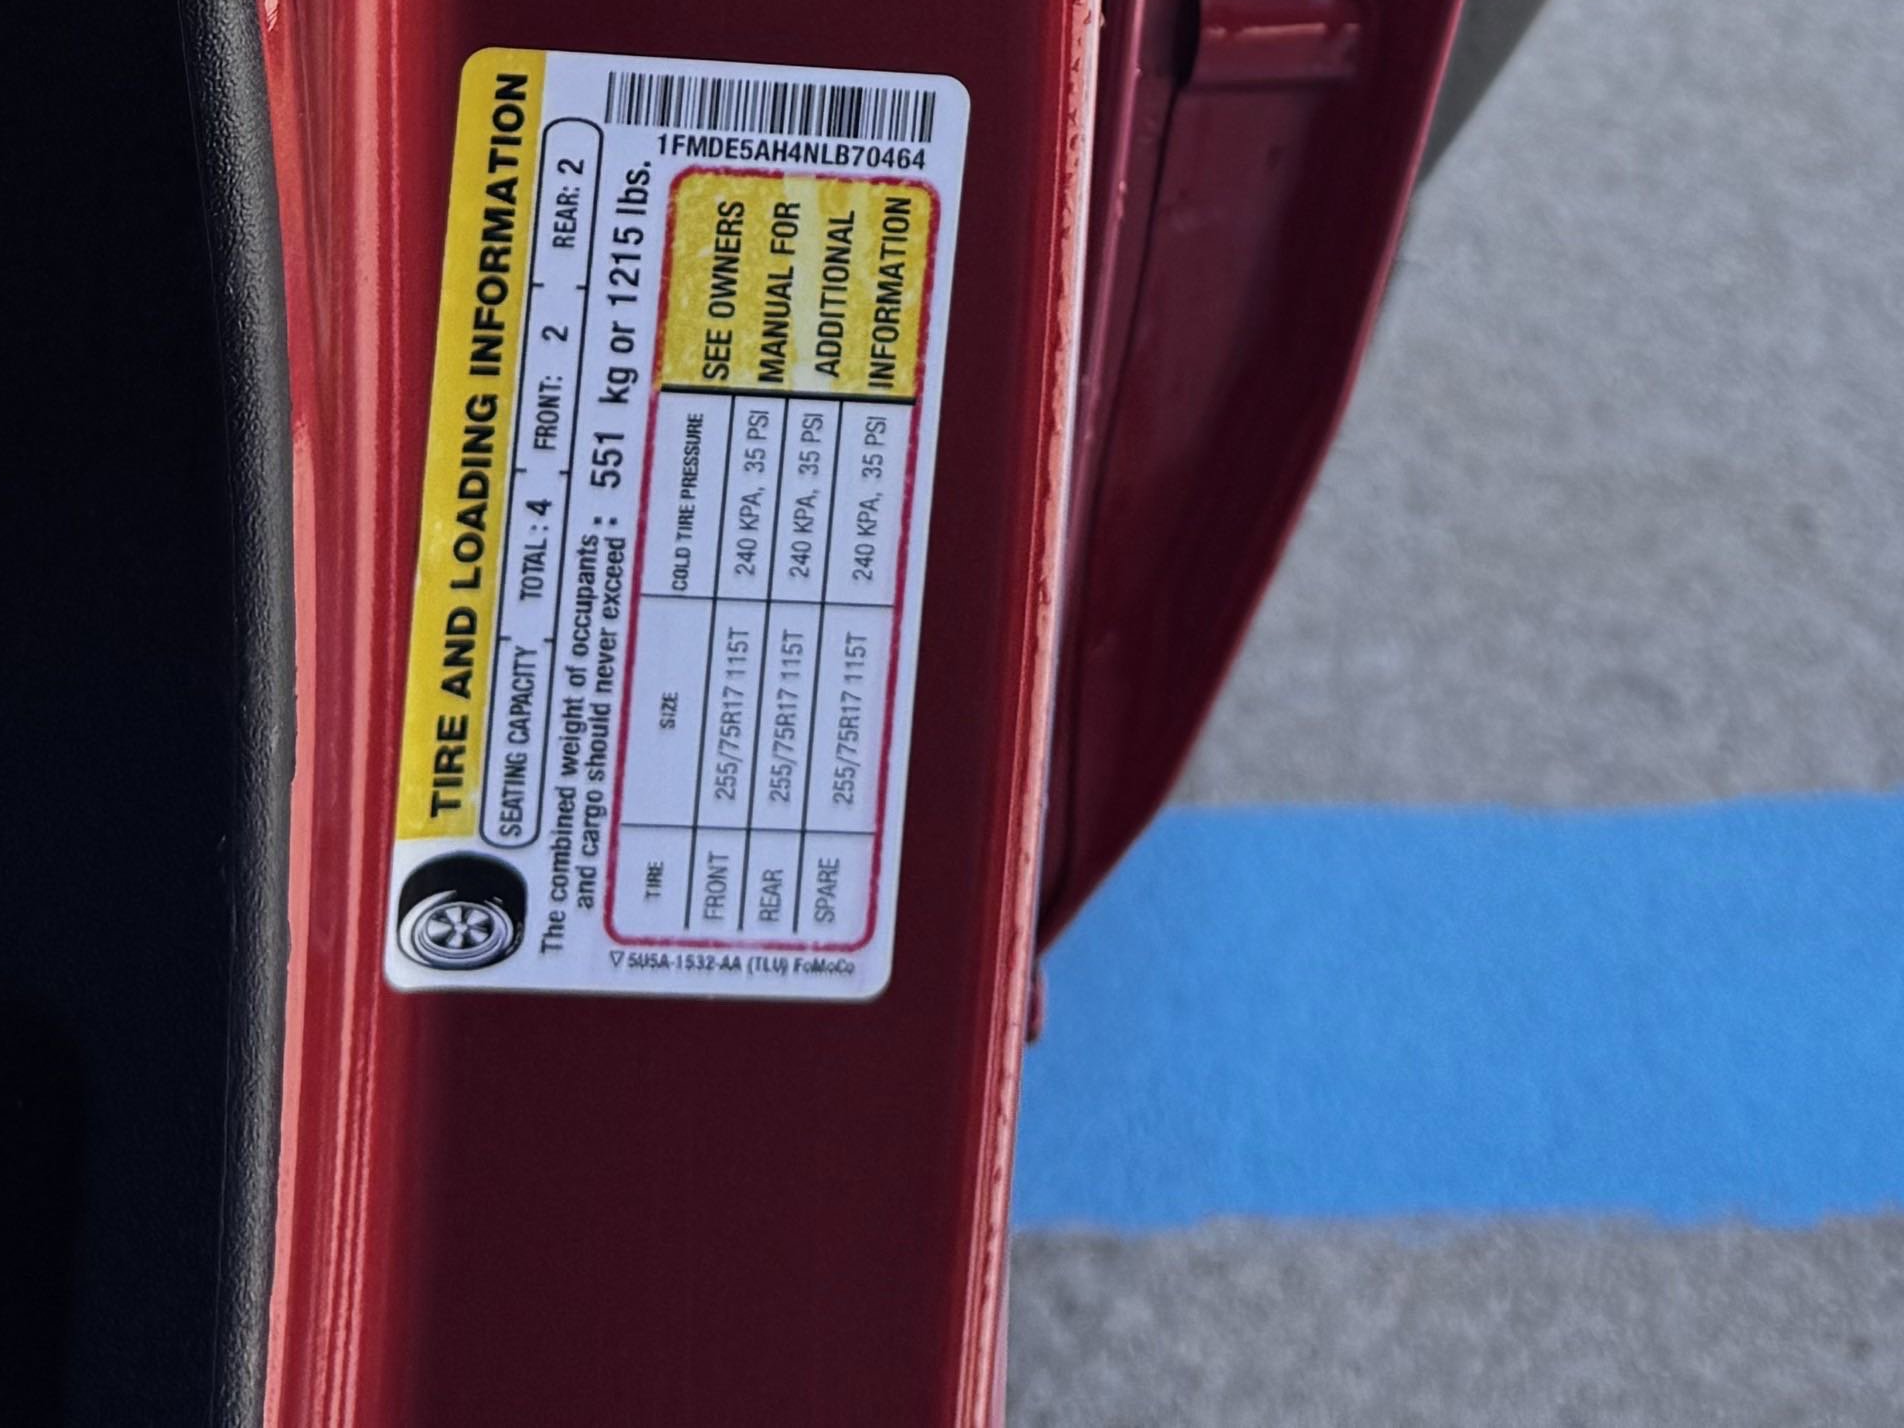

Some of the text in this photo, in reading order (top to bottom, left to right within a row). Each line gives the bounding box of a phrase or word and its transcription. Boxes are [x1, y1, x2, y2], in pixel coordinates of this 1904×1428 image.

[552, 186, 580, 249] REAR:
[656, 133, 927, 170] 1FMDE5AH4NLB70464
[590, 160, 652, 489] 551 kg or 1215 lbs.
[702, 200, 746, 381] SEE OWNERS
[758, 201, 801, 383] MANUAL FOR
[815, 210, 855, 377] ADDITIONAL
[868, 196, 913, 388] INFORMATION
[430, 73, 529, 818] TIRE AND LOADING INFORMATION
[533, 376, 563, 450] FRONT:
[734, 410, 769, 576] 240 35 PSI
[525, 498, 552, 517] 4
[671, 412, 704, 591] COLD TIRE PRESSURE
[499, 645, 537, 837] SEATING CAPACITY
[541, 534, 600, 954] The combined weight of occupants
[576, 537, 626, 910] and cargo should never exceed
[659, 692, 679, 730] SIZE
[714, 626, 750, 801] 255/75R17 115T
[644, 861, 665, 903] TIRE
[705, 851, 730, 921] FRONT
[758, 869, 784, 922] REAR
[814, 858, 840, 924] SPARE
